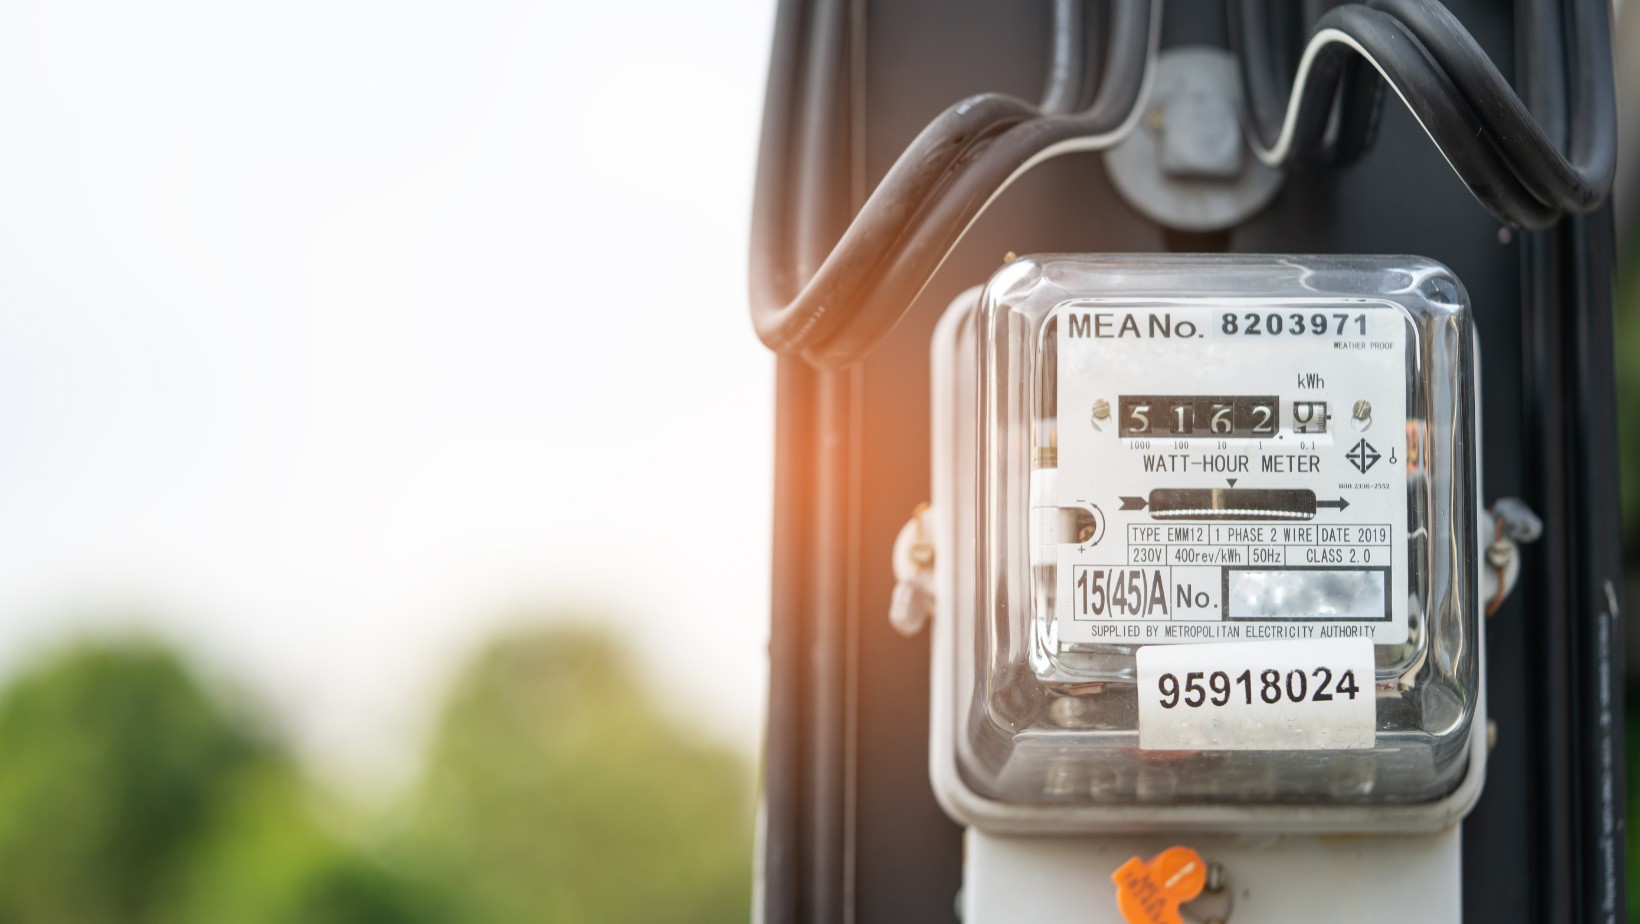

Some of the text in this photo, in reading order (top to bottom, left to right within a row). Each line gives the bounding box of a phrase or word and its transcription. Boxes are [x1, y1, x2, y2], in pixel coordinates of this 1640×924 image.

[1068, 312, 1366, 339] MEA No. 8203971
[1333, 341, 1394, 350] WEATHER PROOF
[1297, 372, 1325, 389] kWh
[1129, 440, 1151, 450] 1000
[1174, 441, 1189, 450] 100
[1217, 441, 1227, 451] 10
[1300, 441, 1316, 451] 0.1
[1143, 454, 1321, 473] WATT-HOUR METER
[1132, 527, 1204, 542] TYPE EMM12
[1215, 527, 1313, 543] 1 PHASE 2 WIRE
[1321, 527, 1386, 543] DATE 2019
[1133, 547, 1162, 563] 230V
[1174, 547, 1241, 564] 400rev/kWh
[1253, 548, 1281, 563] 50Hz
[1306, 547, 1371, 564] CLASS 2.0
[1077, 568, 1169, 618] 15(45)A
[1176, 583, 1218, 609] No.
[1091, 624, 1376, 639] SUPPLIED BY METROPOLITAN ELECTRICITY AUTHORITY
[1158, 666, 1360, 710] 95918024
